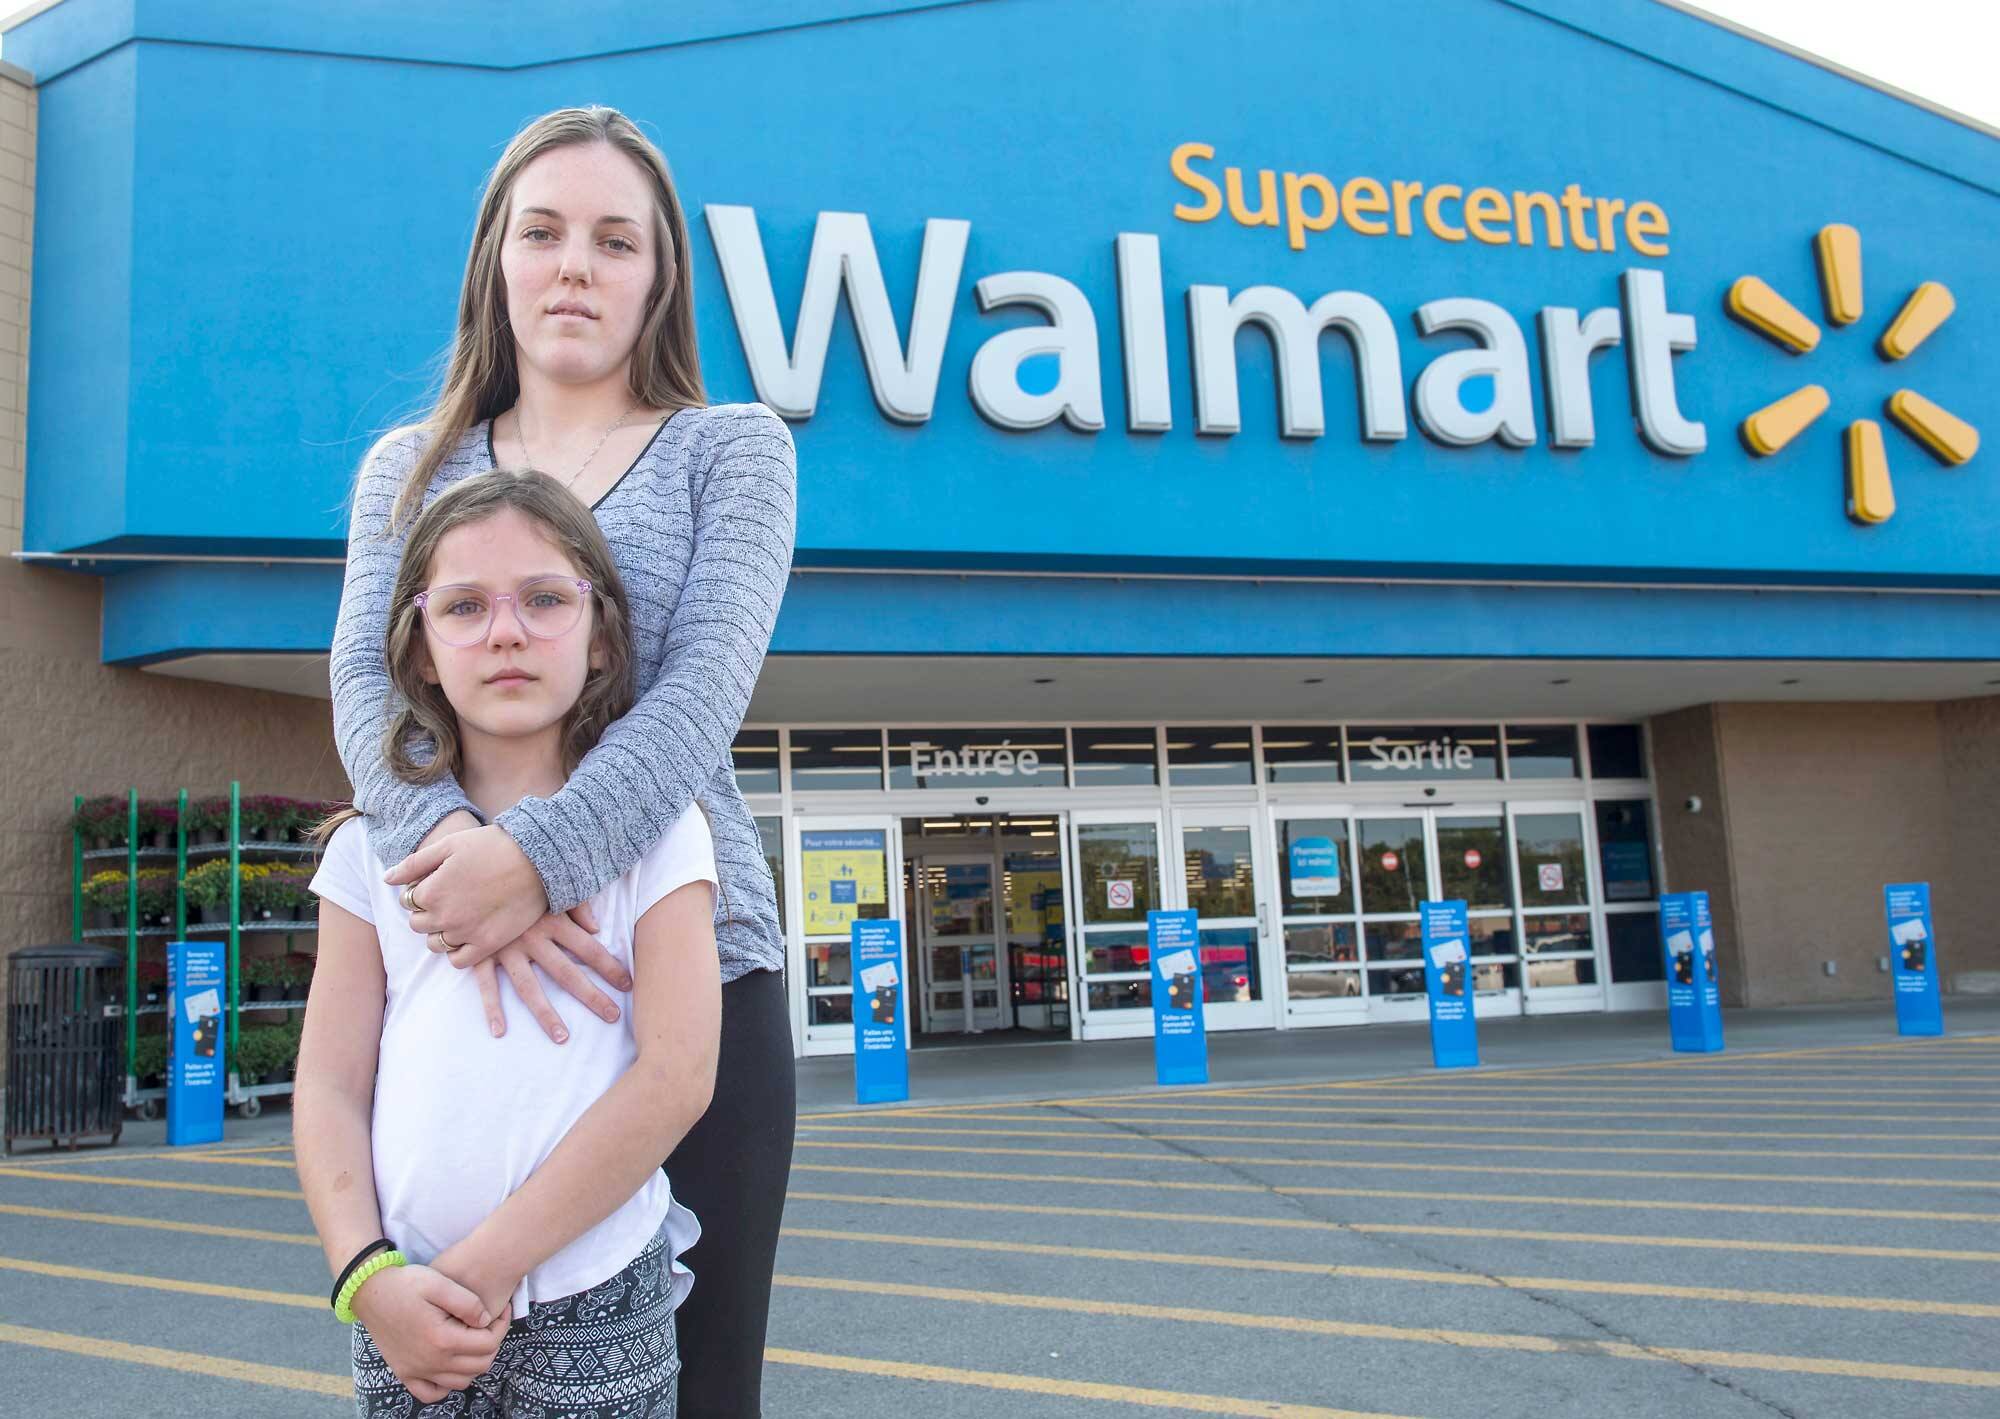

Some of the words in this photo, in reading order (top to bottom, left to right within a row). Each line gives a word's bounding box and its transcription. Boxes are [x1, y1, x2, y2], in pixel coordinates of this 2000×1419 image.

[1169, 142, 1670, 256] Supercentre
[703, 203, 1708, 456] Walmart
[910, 739, 1040, 777] Entrée
[1368, 736, 1474, 770] Sortie
